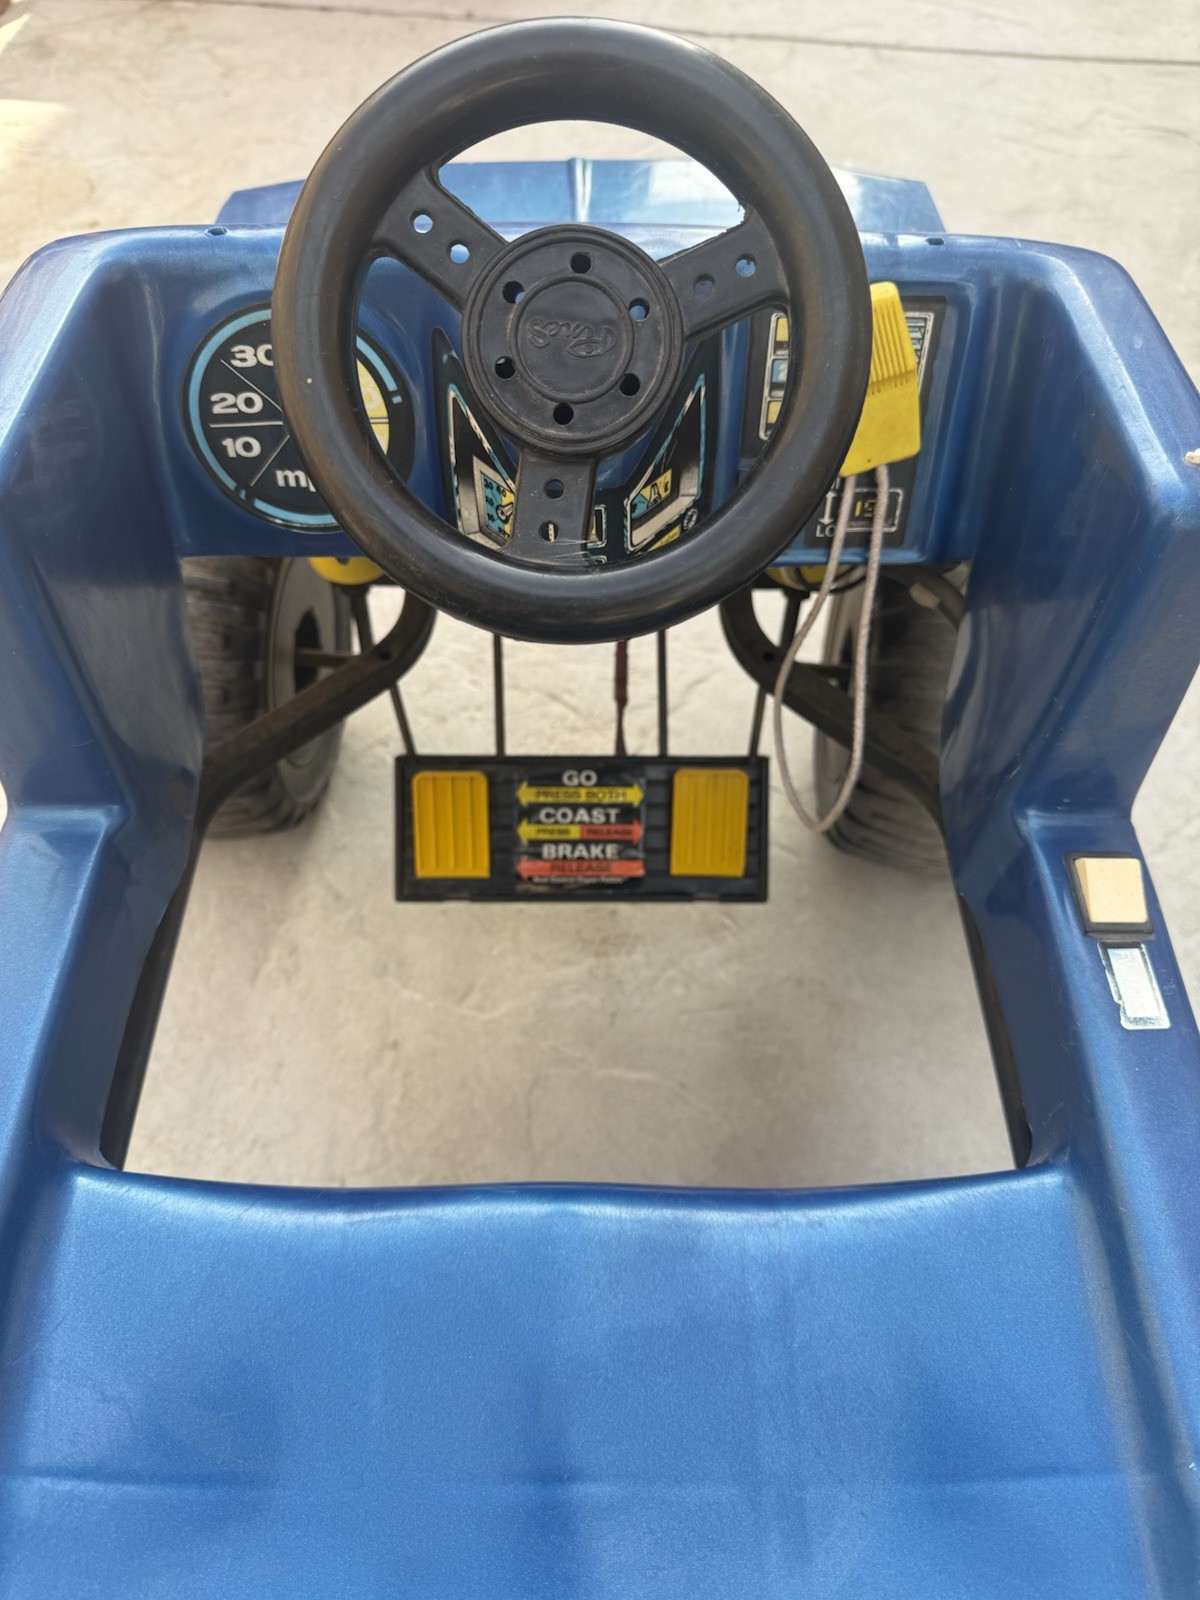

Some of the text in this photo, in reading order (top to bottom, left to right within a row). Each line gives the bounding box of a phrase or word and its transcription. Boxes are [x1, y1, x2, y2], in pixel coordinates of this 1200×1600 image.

[210, 392, 264, 415] 20
[221, 436, 262, 459] 10
[562, 769, 598, 786] GO
[535, 790, 627, 801] PRESS BOTH
[539, 807, 620, 824] COAST
[536, 828, 634, 837] PRESS RELEASE
[541, 843, 619, 860] BRAKE
